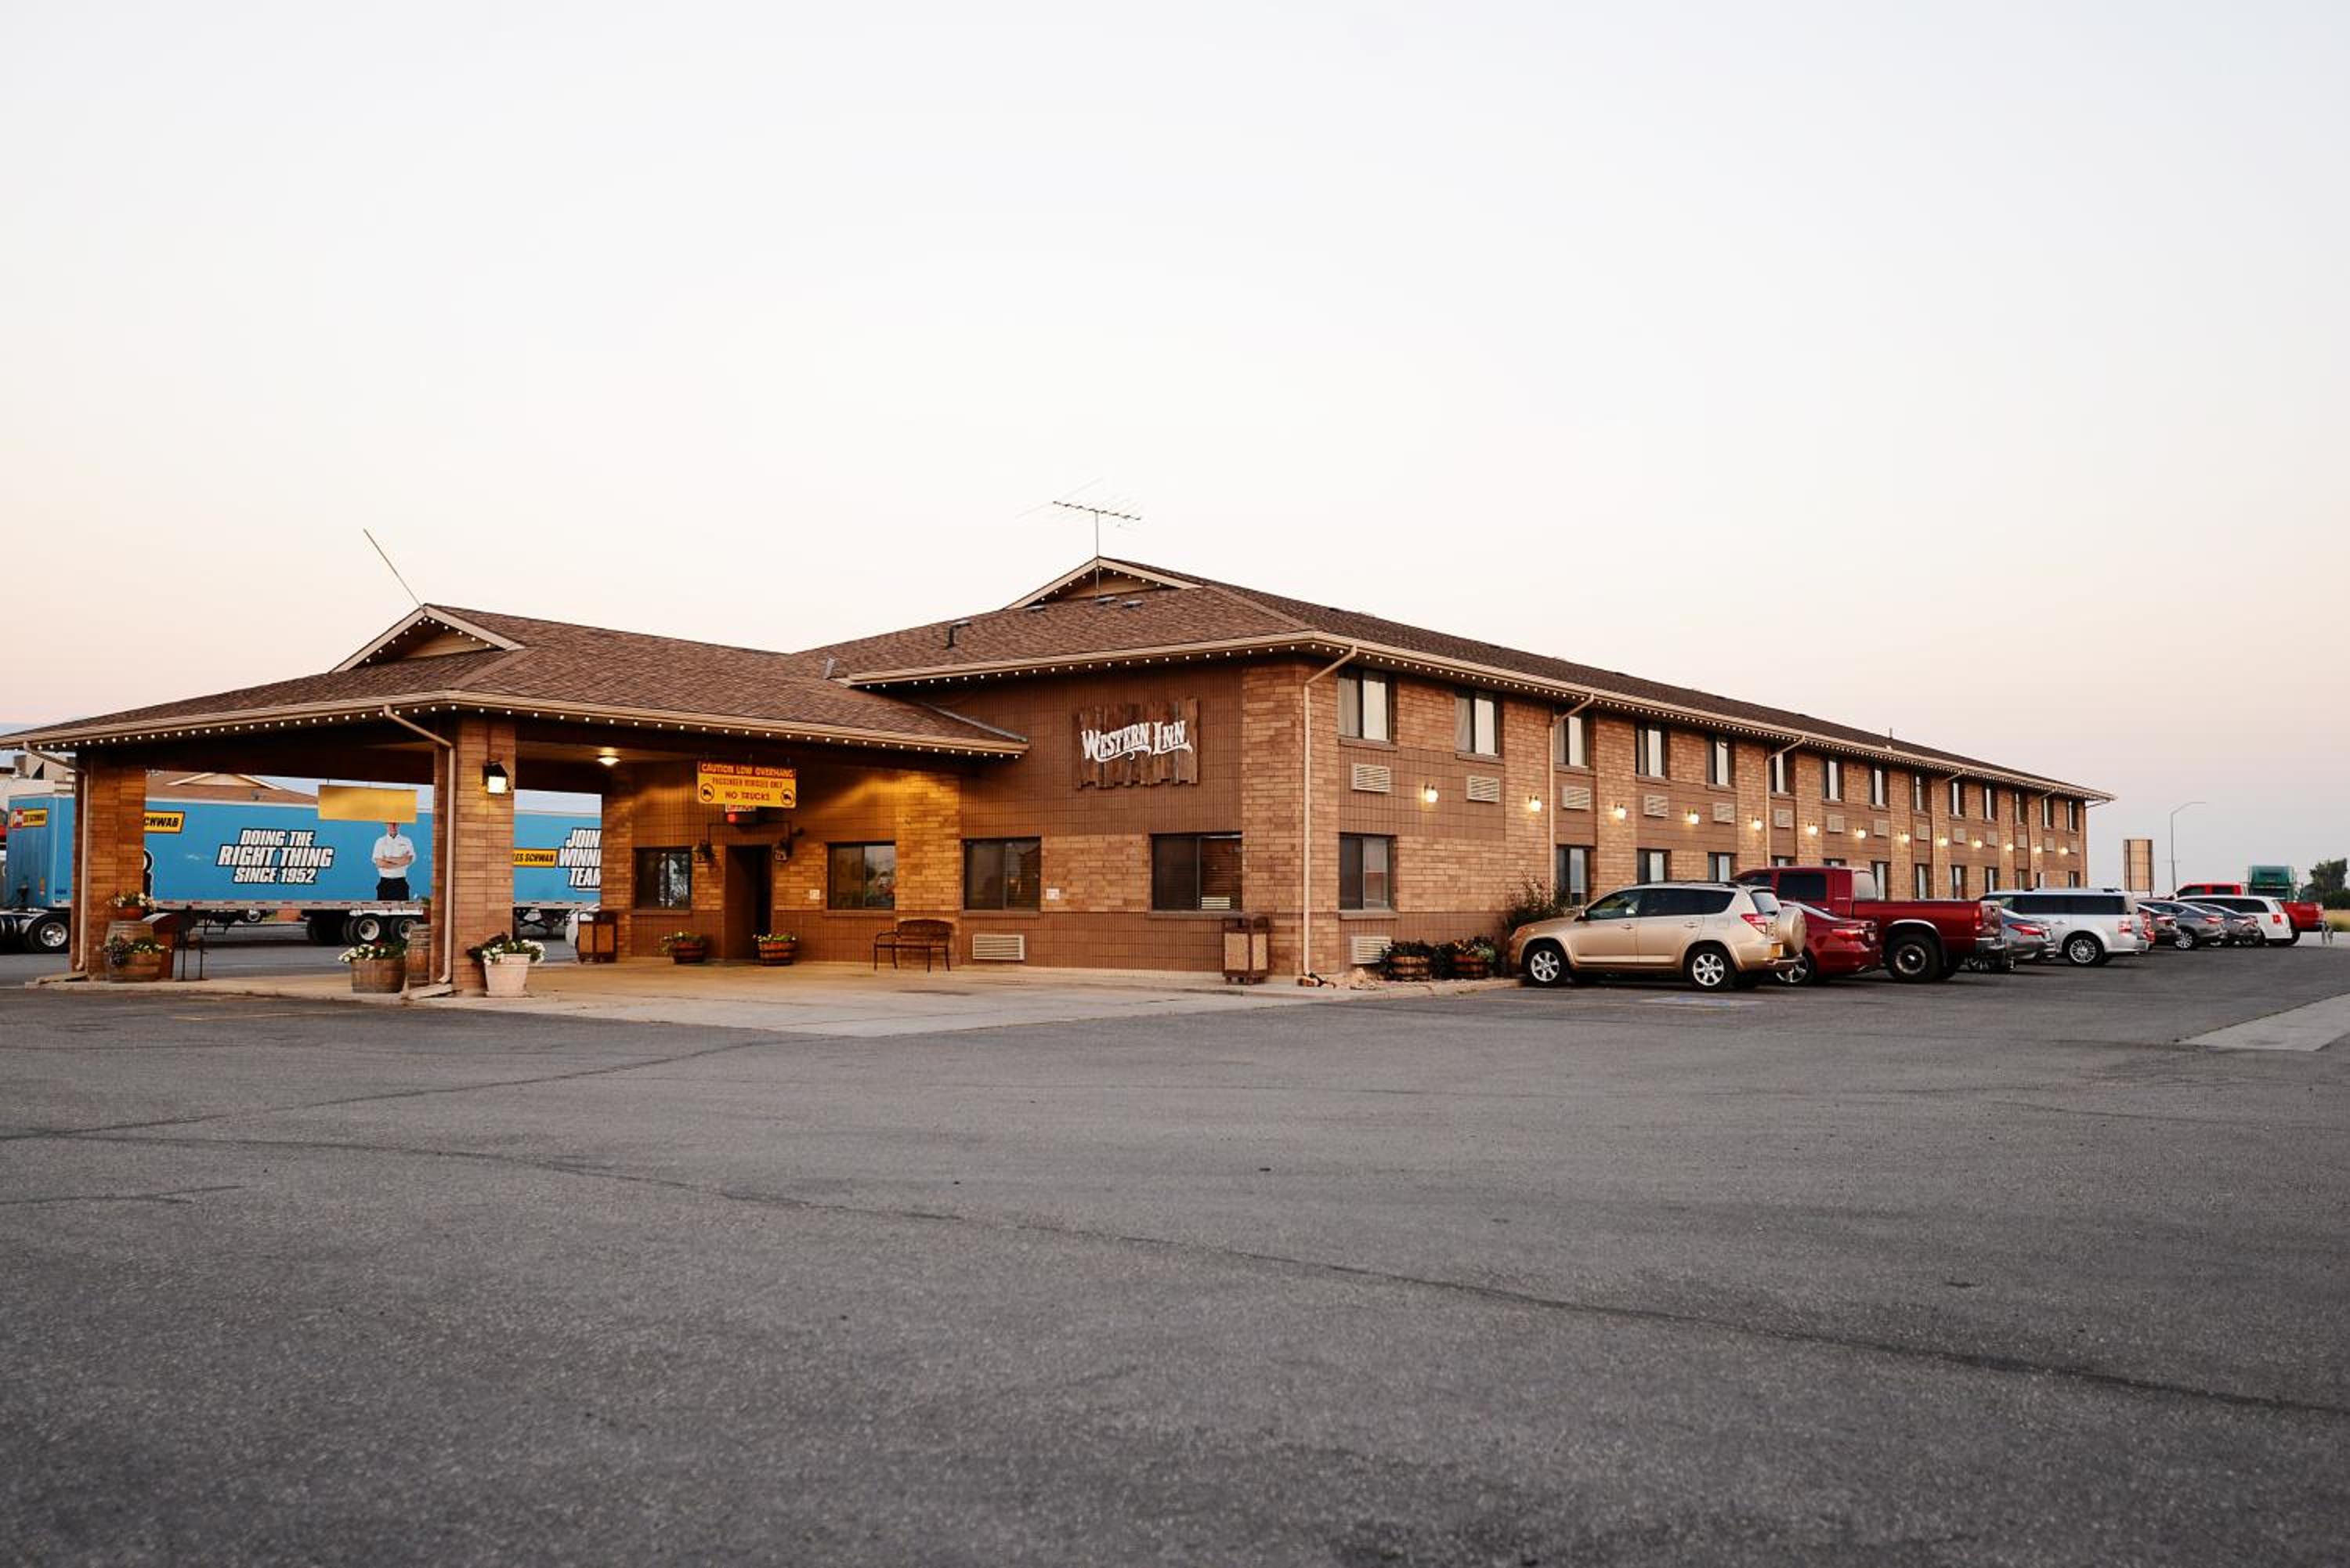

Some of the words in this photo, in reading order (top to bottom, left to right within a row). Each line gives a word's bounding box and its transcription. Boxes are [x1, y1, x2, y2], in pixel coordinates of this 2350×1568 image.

[701, 763, 734, 774] CAUTION
[736, 764, 753, 775] LOW
[725, 791, 738, 800] NO
[741, 792, 770, 801] TRUCKS
[143, 817, 179, 827] CHWAB
[240, 829, 286, 845] DOING
[289, 831, 314, 847] THE
[566, 829, 602, 848] JOIN
[217, 845, 277, 865] RIGHT
[280, 847, 334, 867] THING
[233, 867, 277, 883] SINCE
[280, 867, 316, 883] 1952
